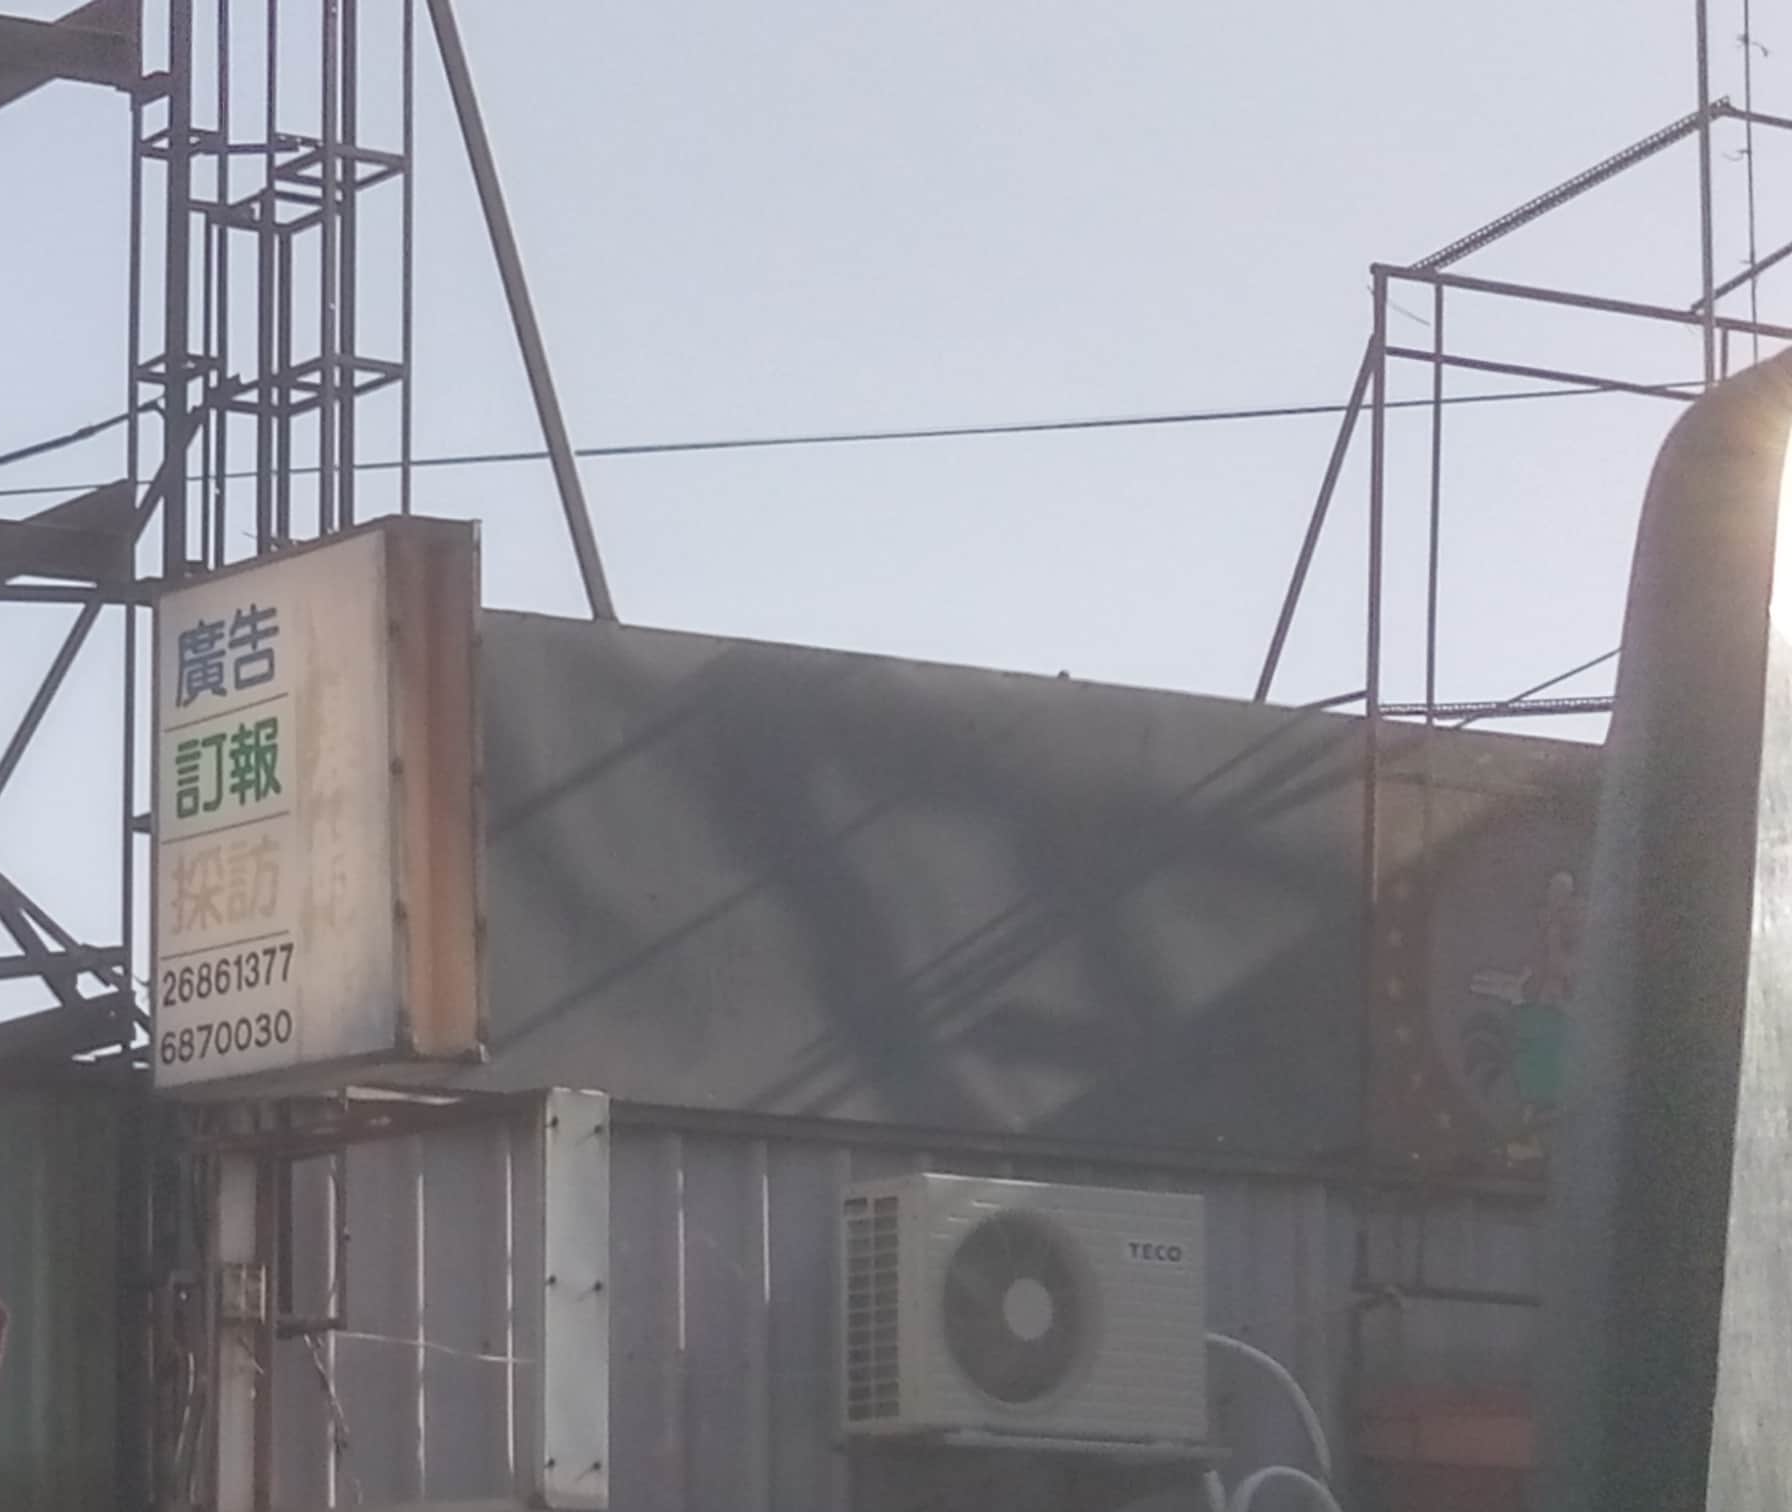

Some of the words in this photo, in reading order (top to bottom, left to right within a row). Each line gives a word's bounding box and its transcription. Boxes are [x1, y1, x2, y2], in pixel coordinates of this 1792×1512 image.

[176, 604, 280, 708] 廣告
[175, 717, 282, 819] 訂報
[171, 834, 282, 936] 採訪
[162, 942, 295, 1006] 26861377
[161, 1009, 293, 1065] 6870030
[1129, 1242, 1182, 1263] TECO
